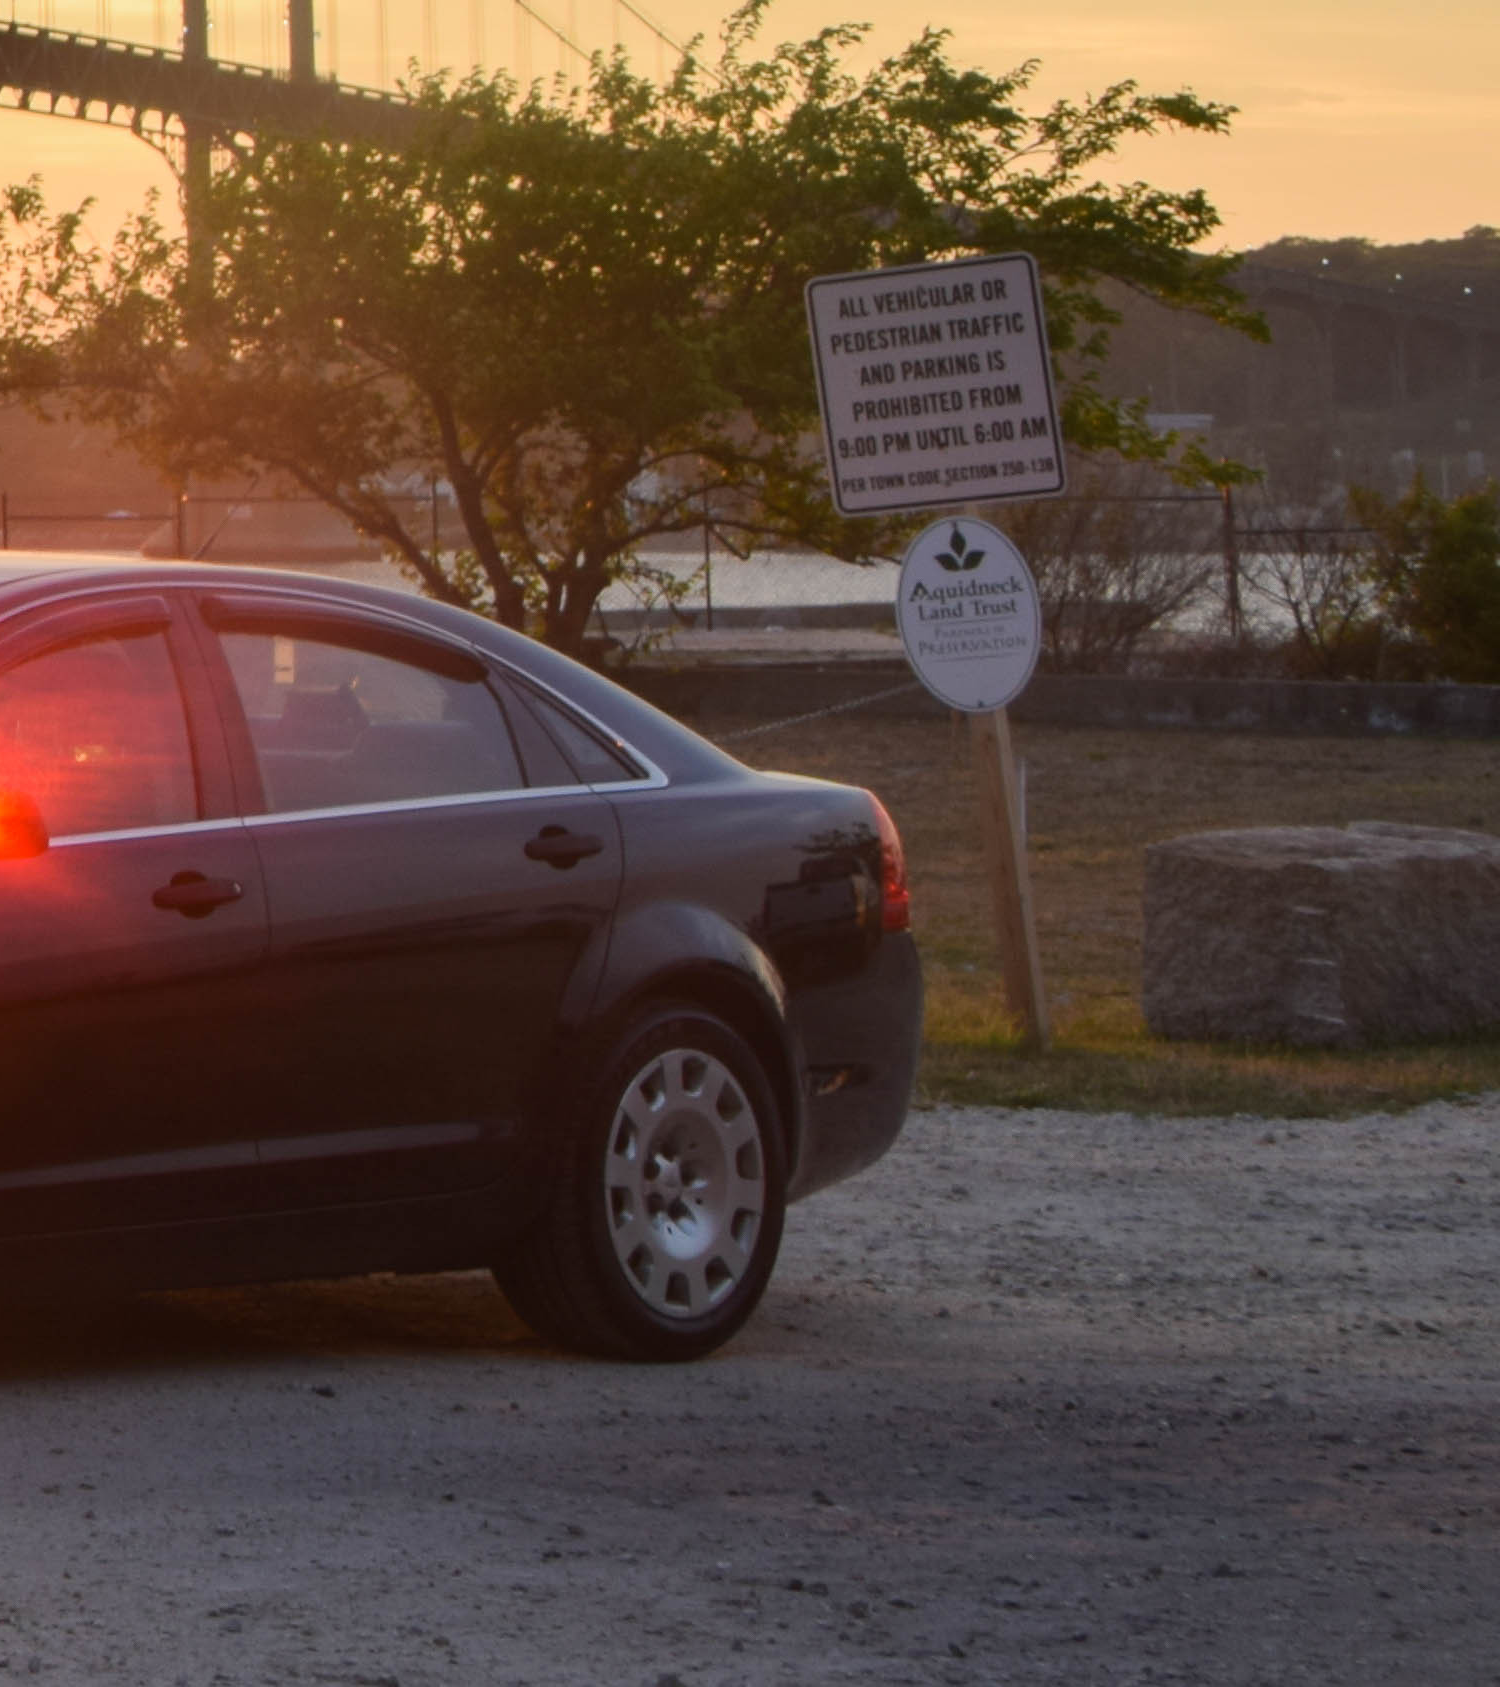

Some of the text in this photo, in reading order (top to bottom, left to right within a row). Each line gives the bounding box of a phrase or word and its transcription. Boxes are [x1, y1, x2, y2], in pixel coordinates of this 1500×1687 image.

[839, 279, 1007, 319] ALL VEHICULAR OR
[831, 313, 1024, 354] PEDESTRIAN TRAFFIC
[860, 350, 1006, 387] AND PARKING IS
[853, 383, 1023, 422] PROHIBITED FROM
[838, 415, 1048, 459] 9:00 PM UNTIL 6:00 AM
[842, 478, 867, 494] PER
[870, 473, 905, 492] TOWN
[908, 469, 940, 487] CODE
[944, 463, 998, 484] SECTION
[910, 576, 1024, 605] Aquidneck
[918, 600, 1017, 621] Land Trust
[918, 636, 1028, 656] PRESERVATION
